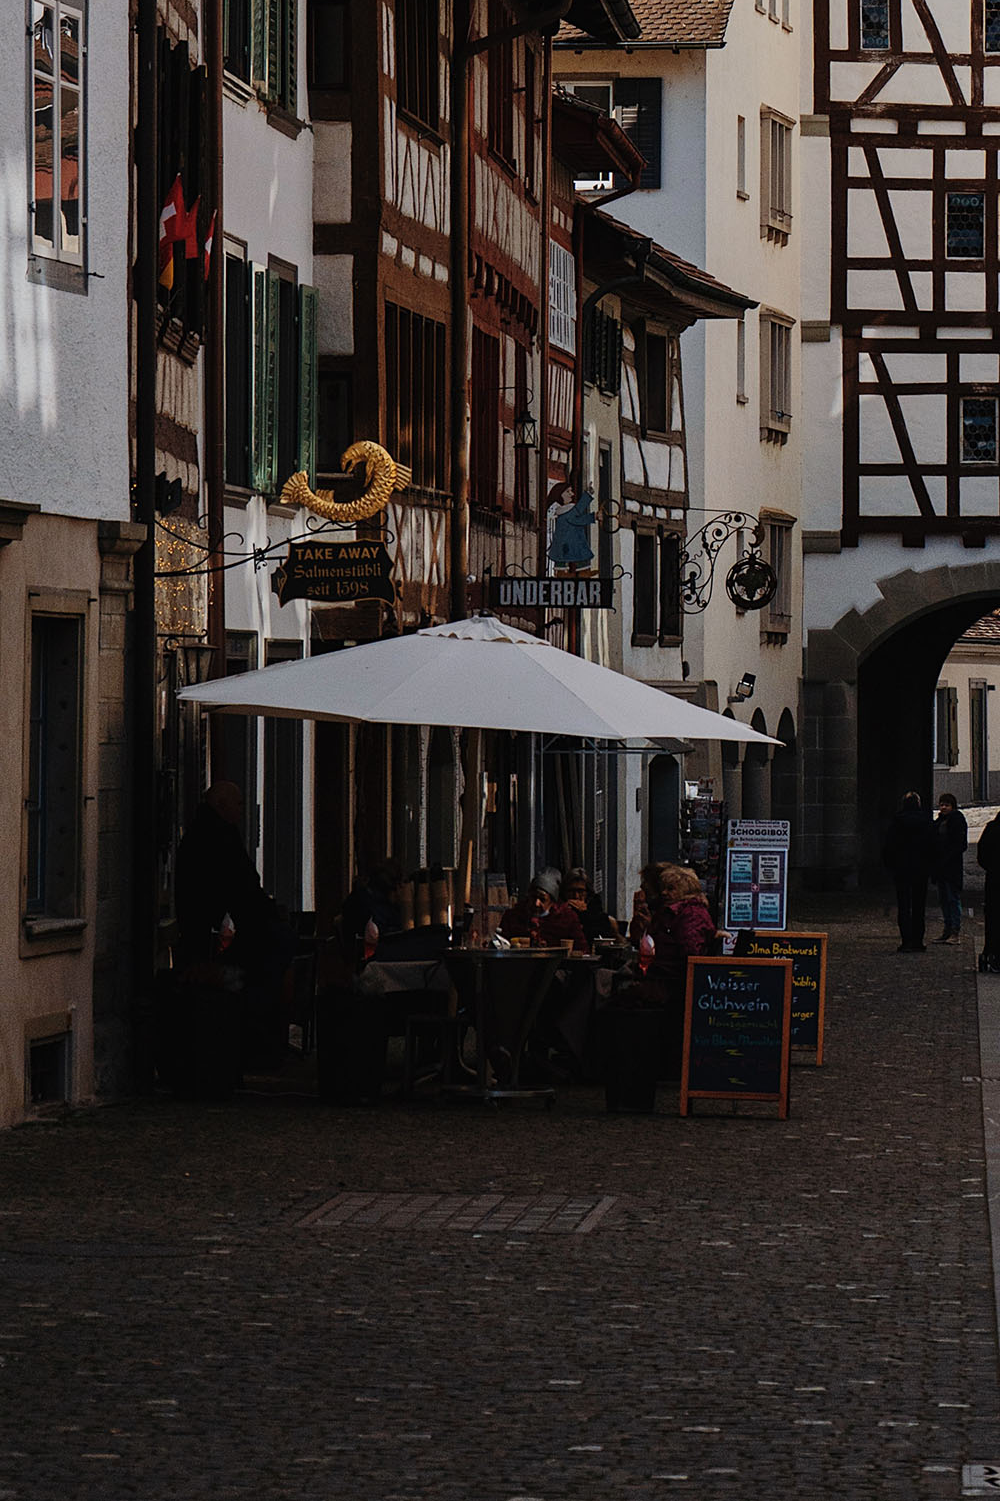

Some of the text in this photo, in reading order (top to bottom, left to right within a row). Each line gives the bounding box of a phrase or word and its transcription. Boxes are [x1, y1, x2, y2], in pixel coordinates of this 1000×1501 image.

[296, 546, 379, 560] TAKE AWAY
[294, 563, 382, 579] Salmenstübli
[306, 583, 329, 596] seit
[772, 942, 818, 956] Bratwurst
[707, 975, 761, 991] Weisser
[698, 993, 770, 1012] Glühwein
[792, 1011, 815, 1022] urger
